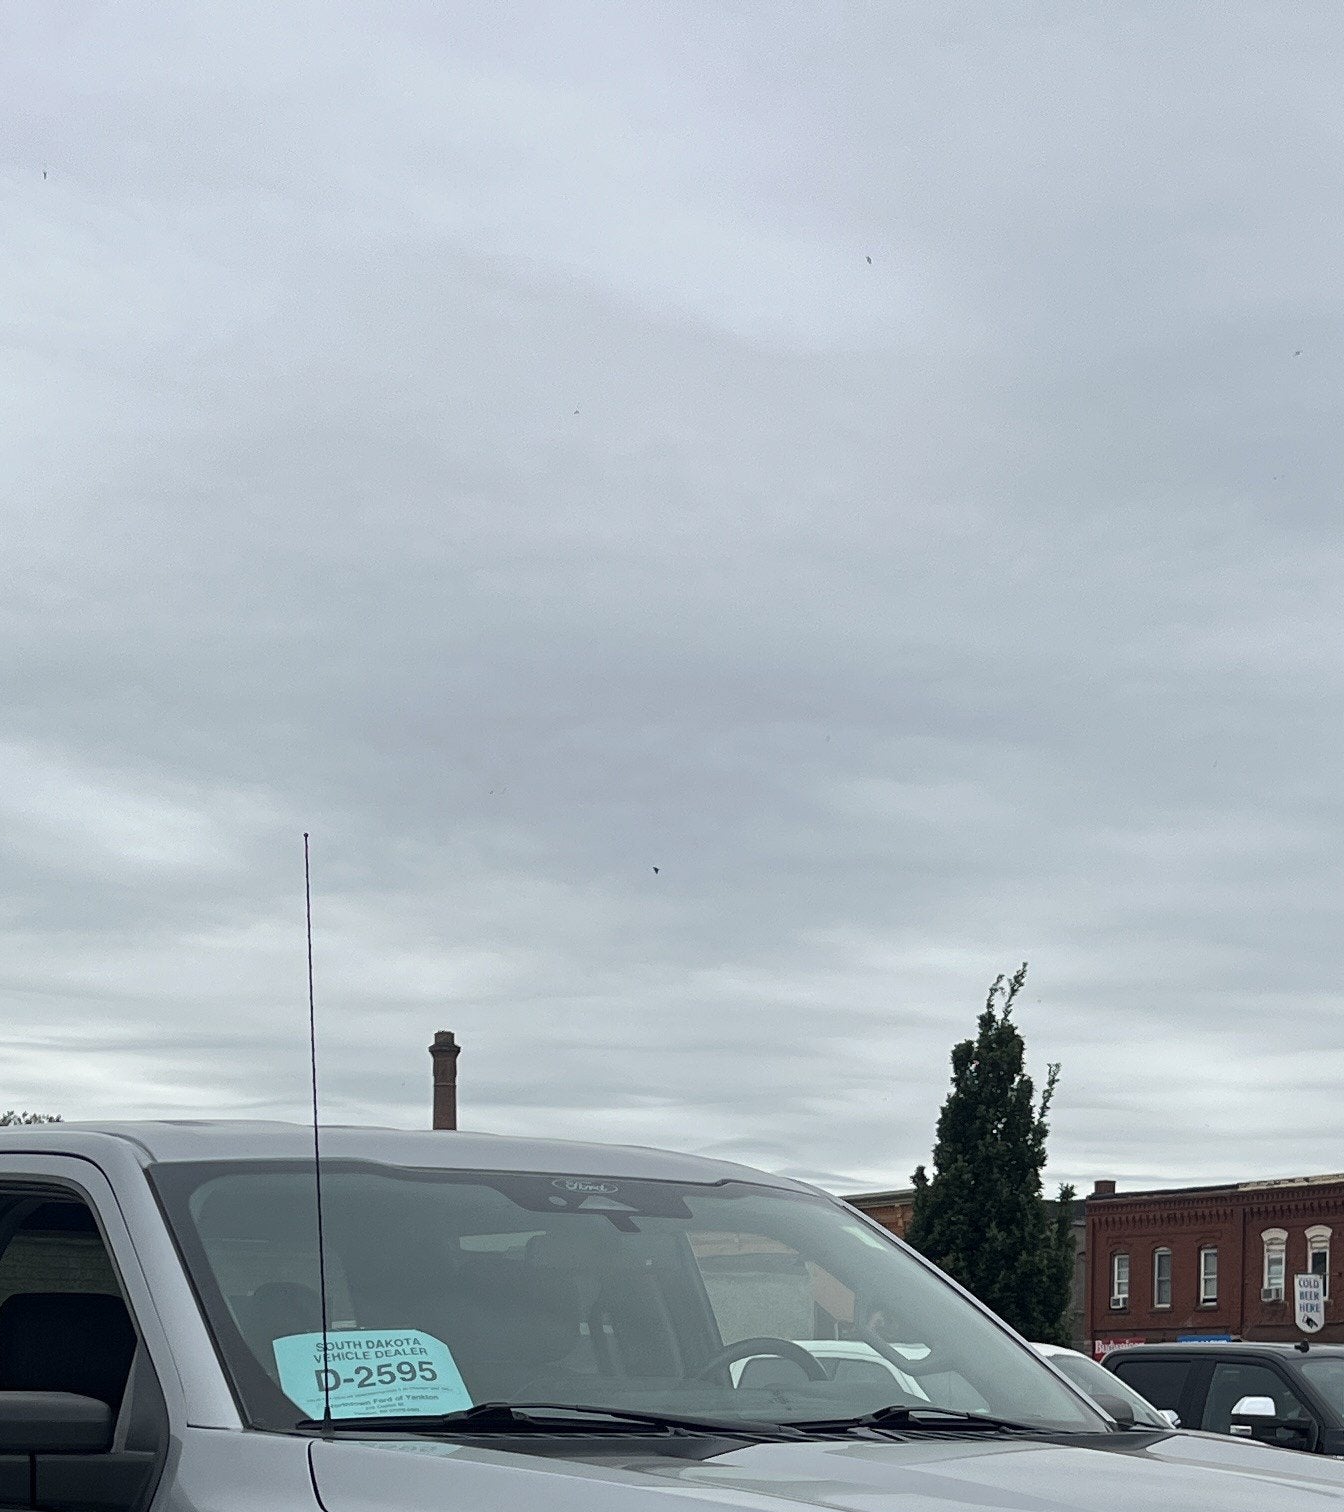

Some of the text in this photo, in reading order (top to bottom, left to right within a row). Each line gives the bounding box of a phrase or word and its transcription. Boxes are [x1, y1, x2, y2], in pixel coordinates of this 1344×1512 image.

[316, 1338, 421, 1352] SOUTH DAKOTA
[314, 1348, 429, 1364] VEHICLE DEALER
[315, 1362, 438, 1392] D-2595
